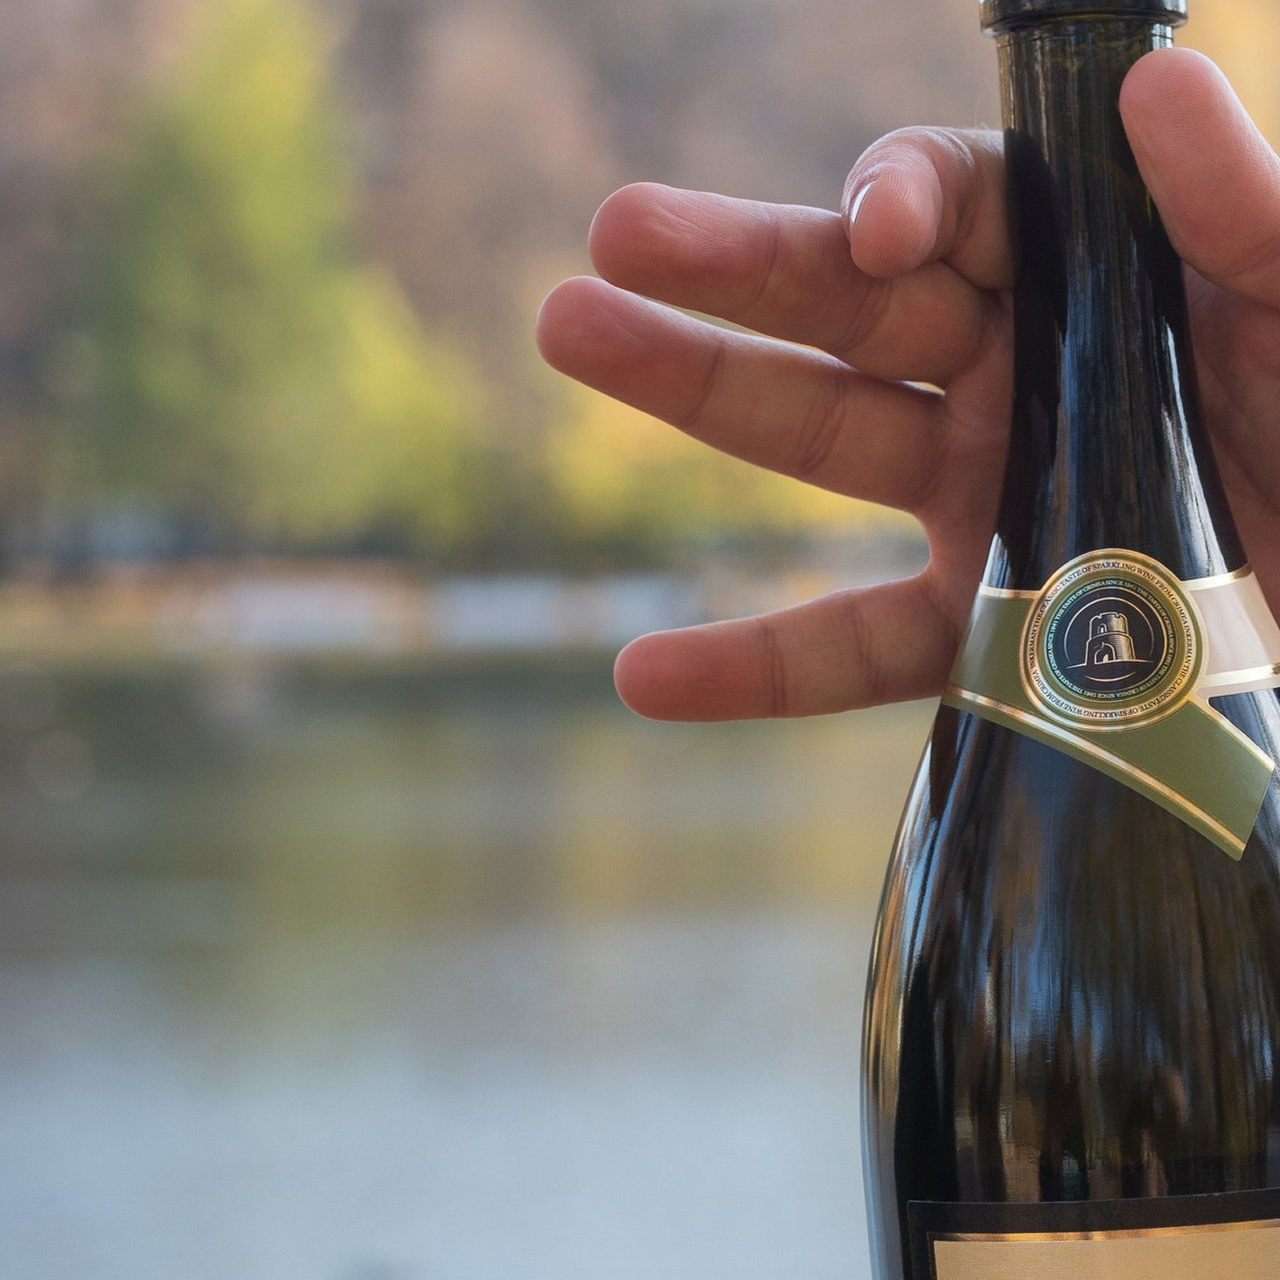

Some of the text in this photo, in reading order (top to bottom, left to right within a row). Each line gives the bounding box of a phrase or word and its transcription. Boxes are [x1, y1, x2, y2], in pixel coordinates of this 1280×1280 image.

[1028, 561, 1193, 718] INKERMAN THE CLASSIC TASTE OF SPARKLING WINE FROM CRIMEA INKERMAN THE CLASSIC TASTE OF SPARKLING WINE FROM CRIMEA
